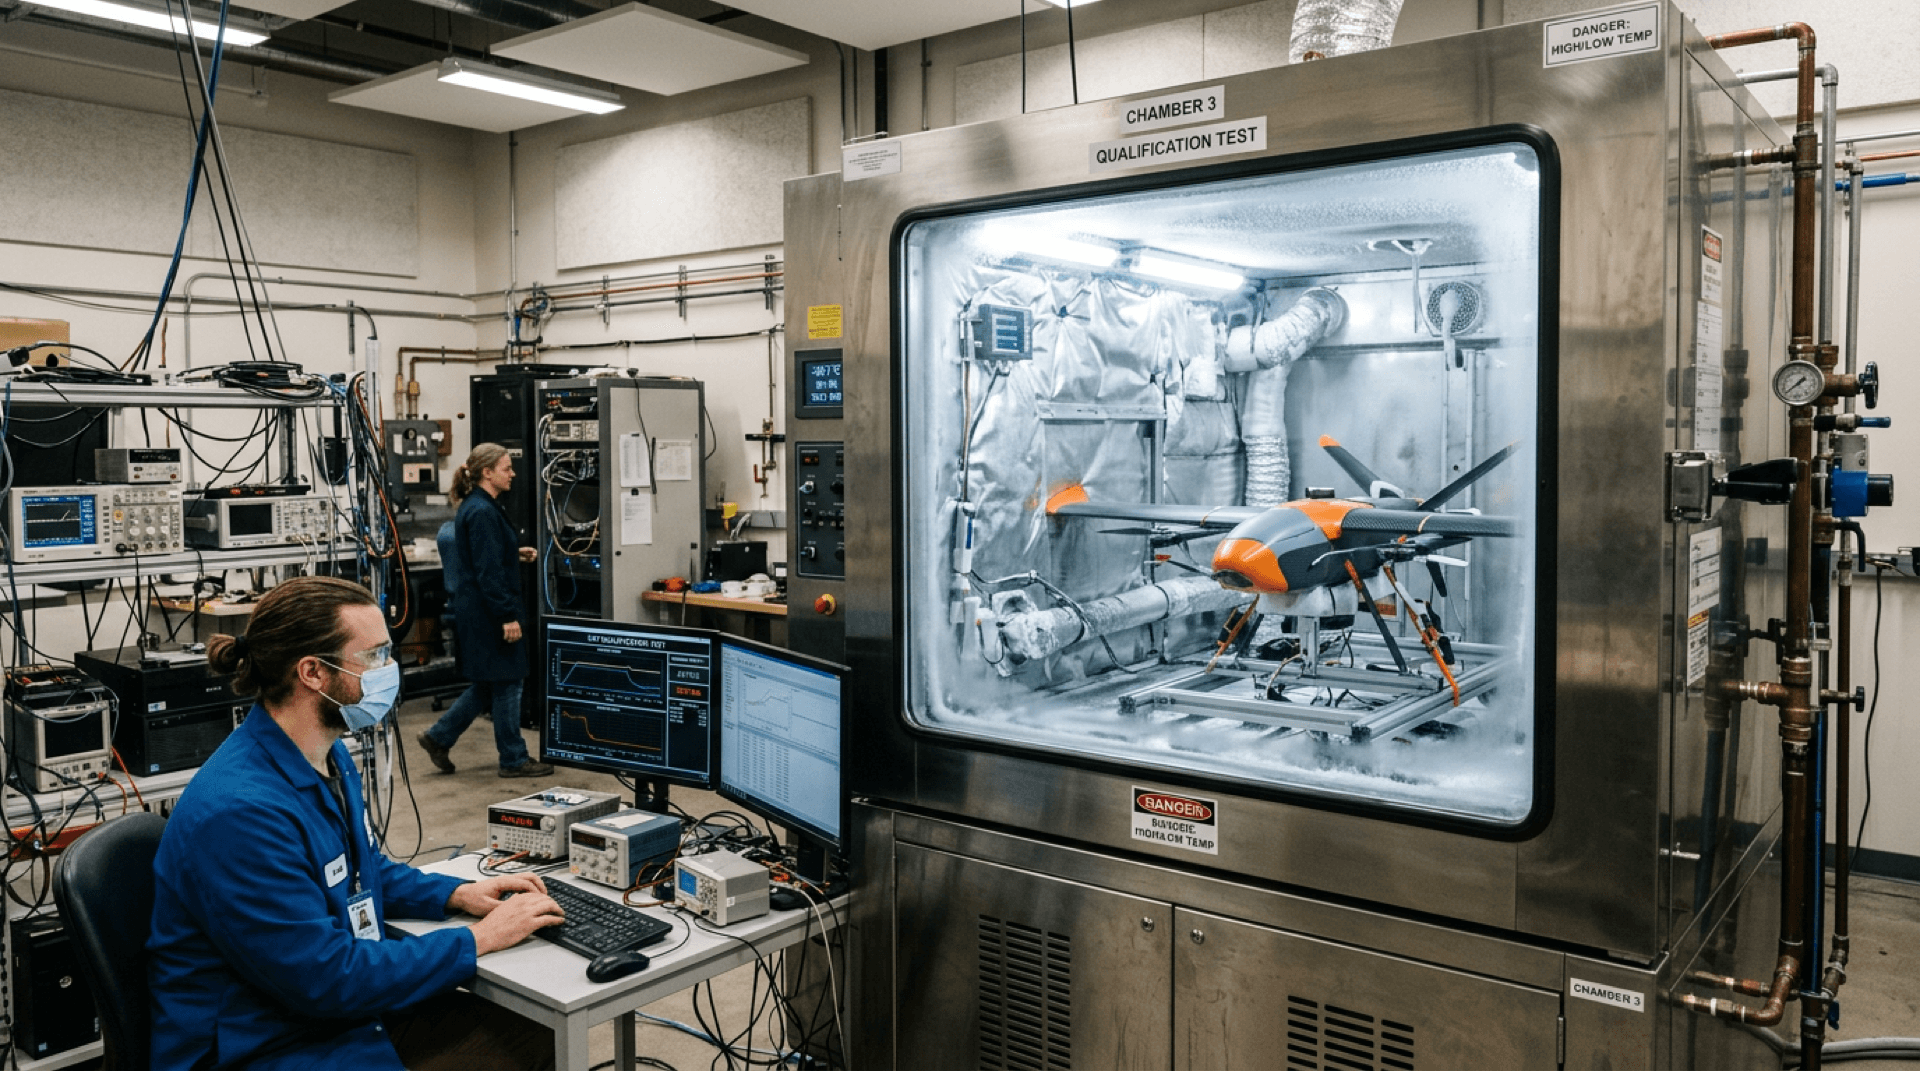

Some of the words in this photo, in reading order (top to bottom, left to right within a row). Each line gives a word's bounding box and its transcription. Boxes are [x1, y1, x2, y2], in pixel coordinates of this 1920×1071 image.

[1572, 19, 1630, 37] DANGER:
[1551, 36, 1614, 55] HIGH/LOW
[1617, 30, 1652, 45] TEMP
[1126, 99, 1203, 124] CHAMBER
[1207, 96, 1216, 110] 3
[1096, 133, 1211, 164] QUALIFICATION
[1215, 127, 1258, 146] TEST
[1634, 997, 1640, 1006] 3
